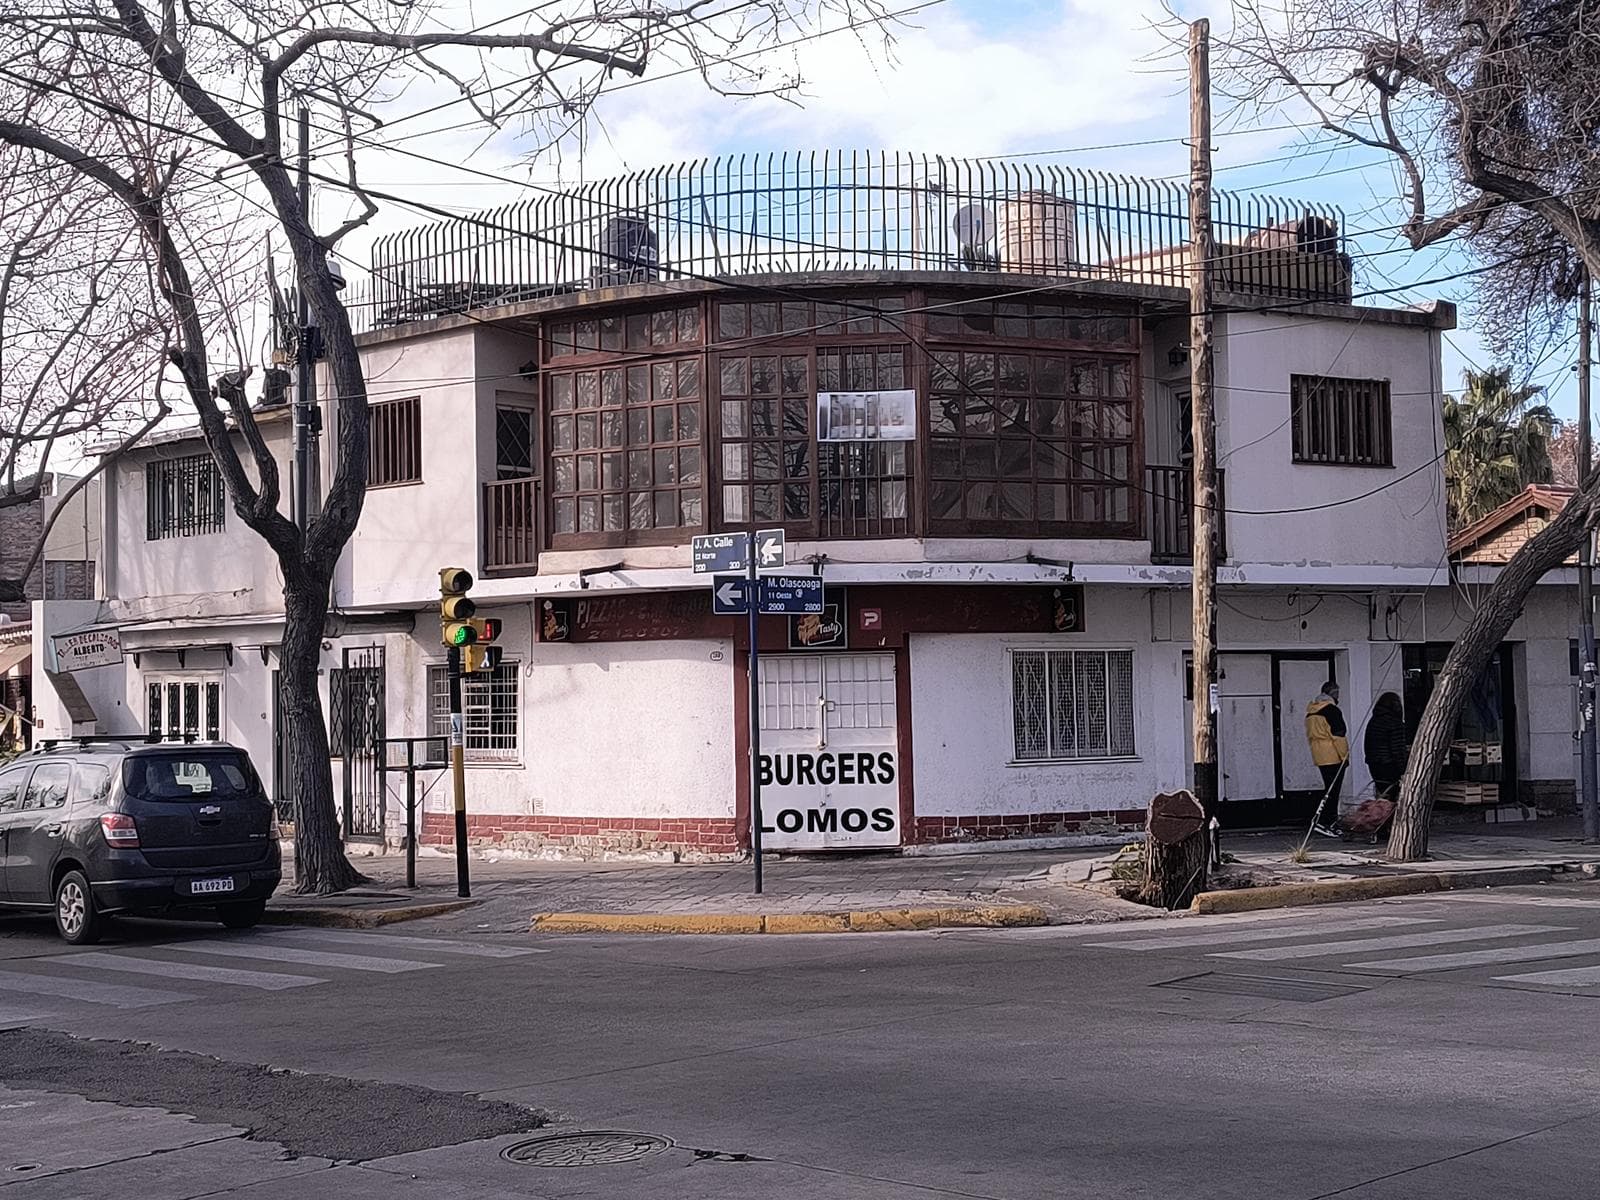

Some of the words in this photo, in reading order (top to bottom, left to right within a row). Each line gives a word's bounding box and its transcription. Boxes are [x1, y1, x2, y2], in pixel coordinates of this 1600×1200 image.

[703, 538, 712, 548] A.
[713, 537, 734, 548] Calle
[767, 578, 778, 588] M.
[779, 577, 821, 591] Olascoaga
[819, 622, 839, 635] Tasty
[759, 752, 895, 786] BURGERS
[194, 883, 203, 891] AA
[205, 881, 220, 890] 692
